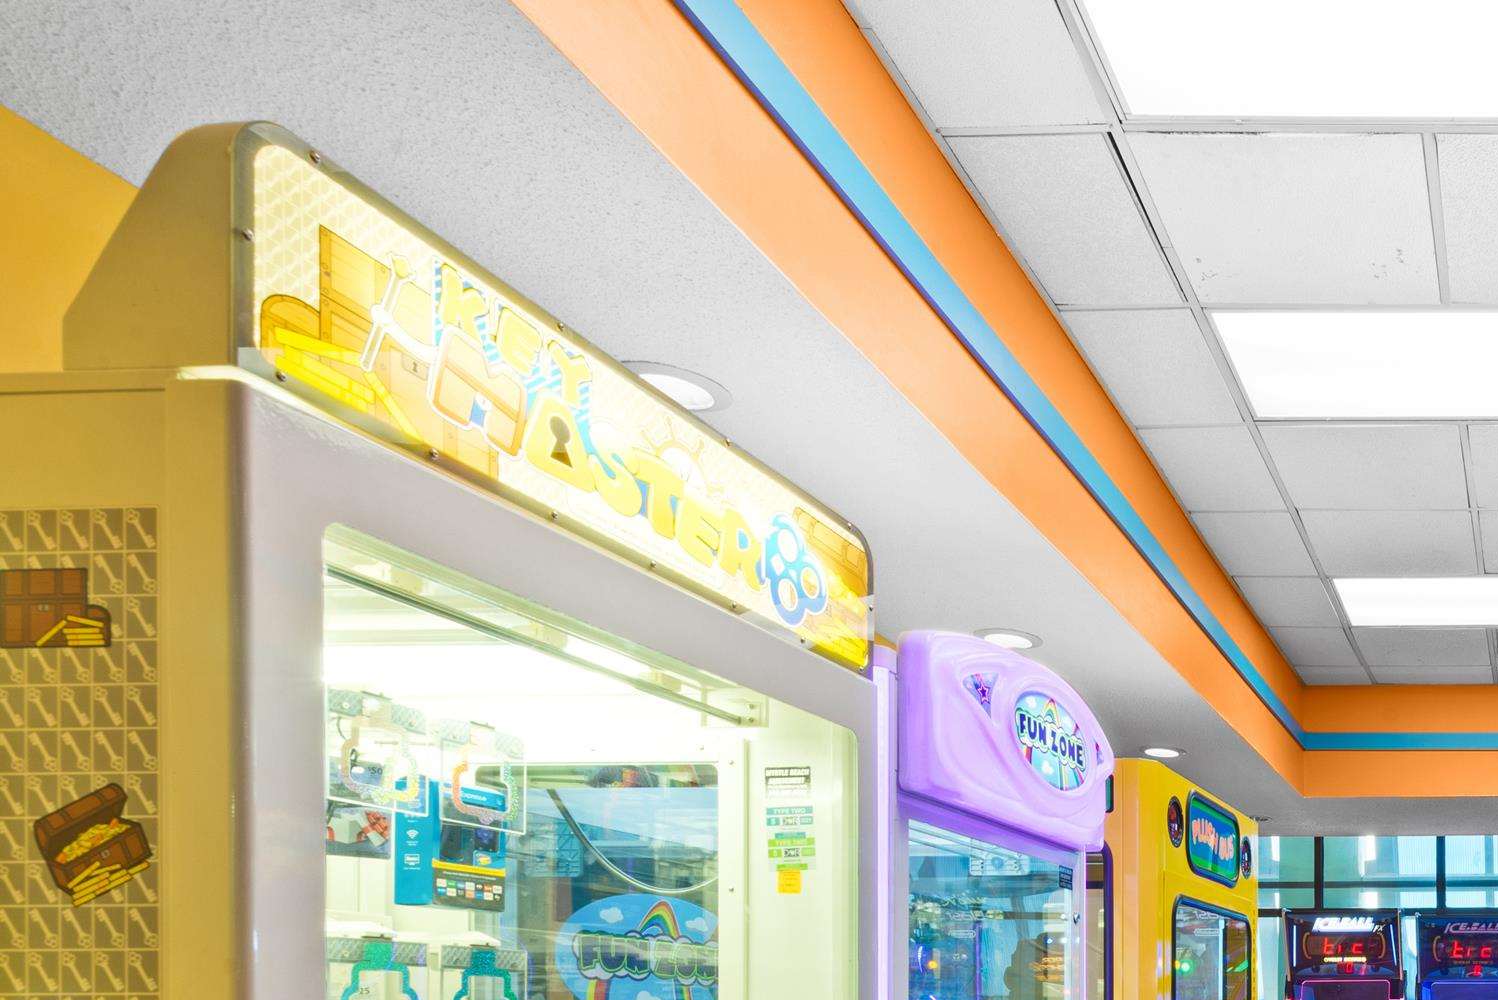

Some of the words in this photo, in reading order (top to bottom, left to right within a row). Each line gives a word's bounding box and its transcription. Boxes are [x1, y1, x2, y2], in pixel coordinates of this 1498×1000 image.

[436, 262, 593, 408] KEY
[427, 325, 764, 590] MASTER
[1020, 713, 1047, 745] FUN
[1051, 730, 1084, 767] ZONE
[1373, 924, 1385, 933] FX
[578, 935, 651, 975] FUN
[652, 939, 718, 978] ZON
